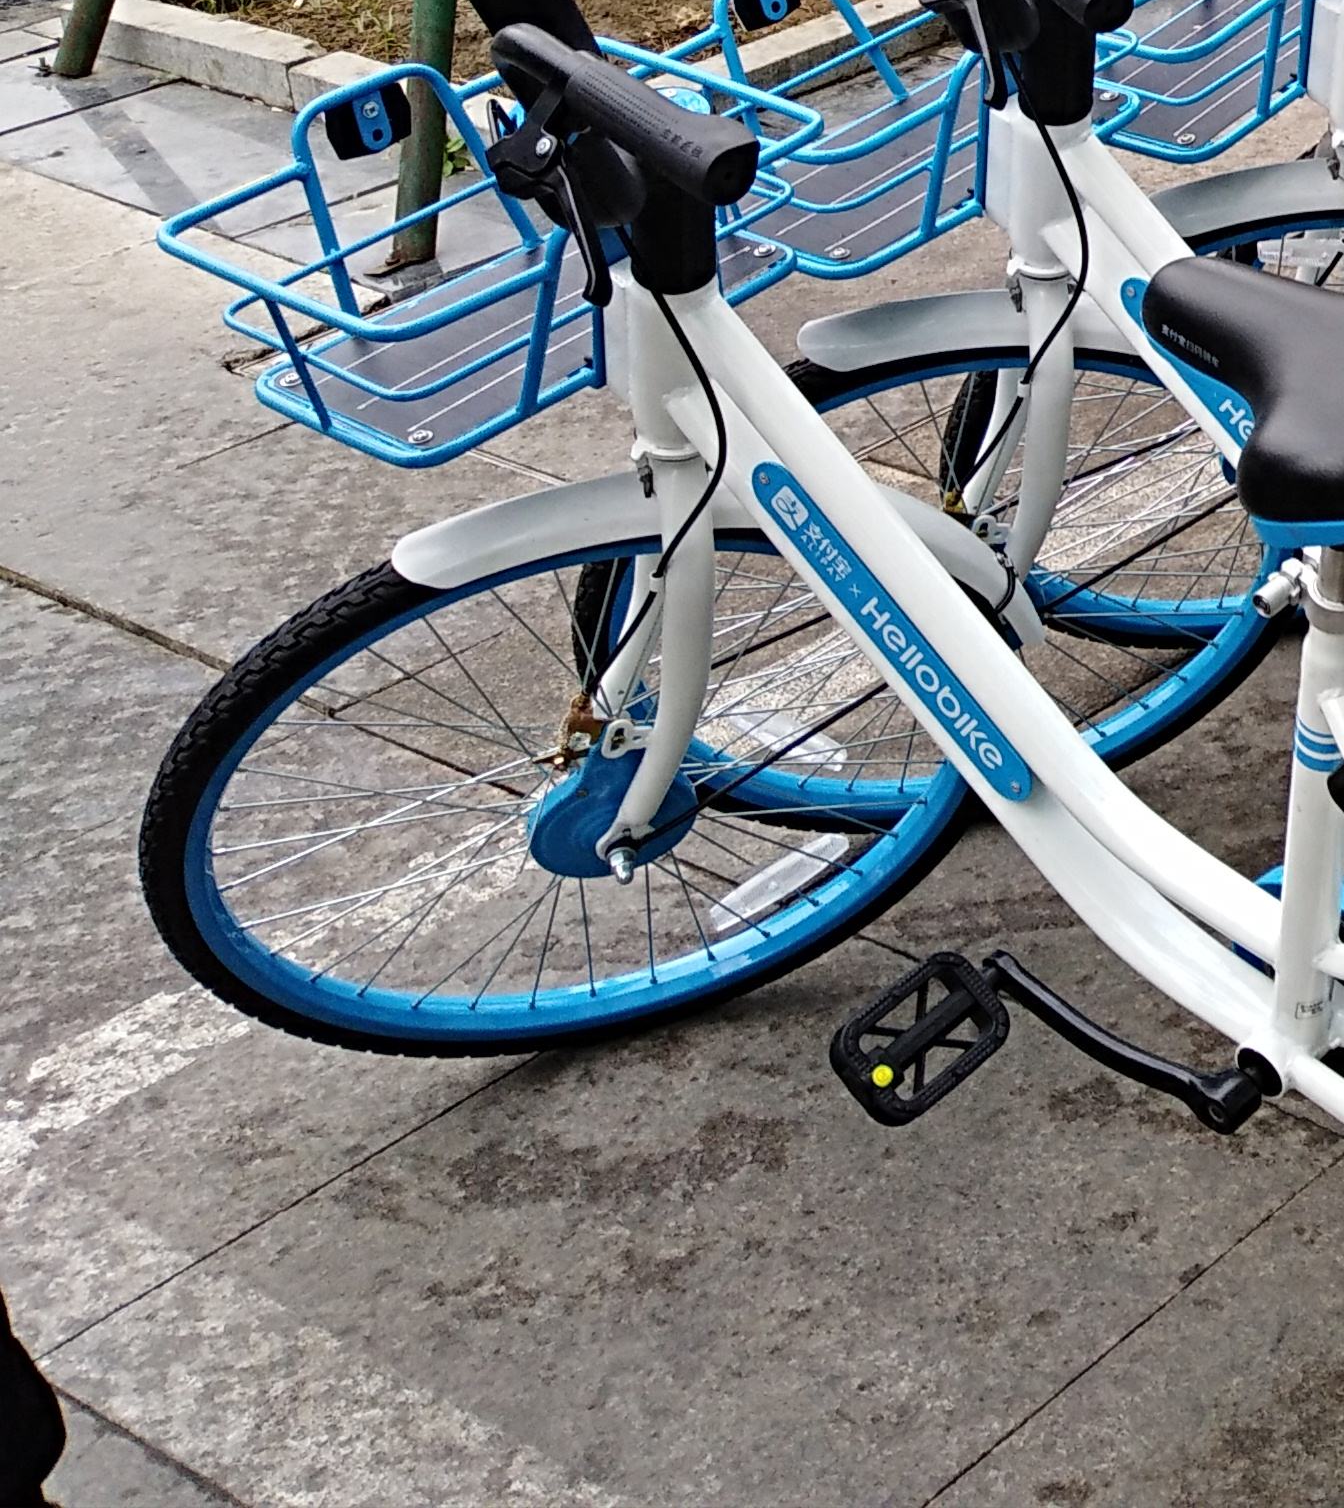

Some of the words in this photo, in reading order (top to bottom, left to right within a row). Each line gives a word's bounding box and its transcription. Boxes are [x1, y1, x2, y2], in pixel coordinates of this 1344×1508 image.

[799, 533, 847, 583] ALIPAY
[803, 522, 853, 579] 支付宝
[860, 597, 1003, 771] Hellobike
